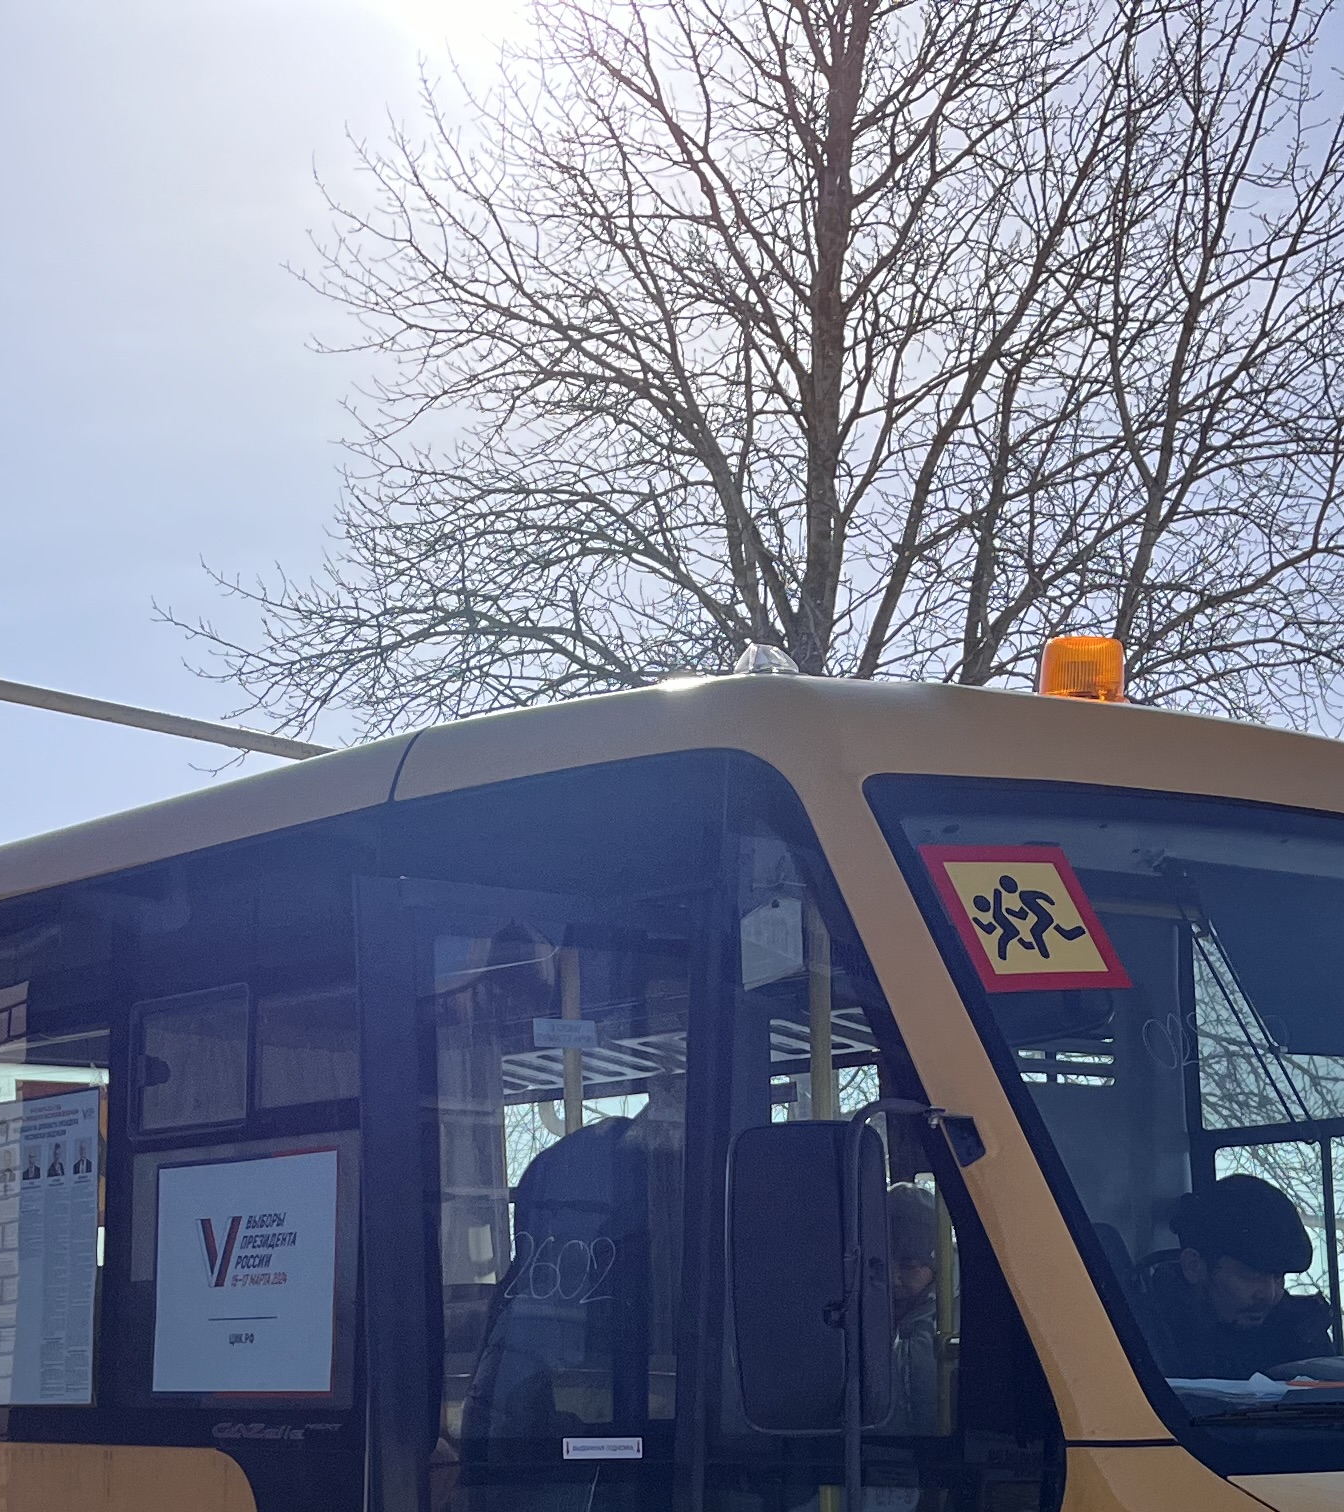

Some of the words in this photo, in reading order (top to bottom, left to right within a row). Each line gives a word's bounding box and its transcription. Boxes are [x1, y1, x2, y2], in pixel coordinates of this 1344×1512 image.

[246, 1212, 286, 1229] ВЫБОРЫ
[240, 1232, 297, 1250] ПРЕЗИДЕНТА
[235, 1254, 272, 1269] РОССИИ
[504, 1231, 616, 1304] 2602
